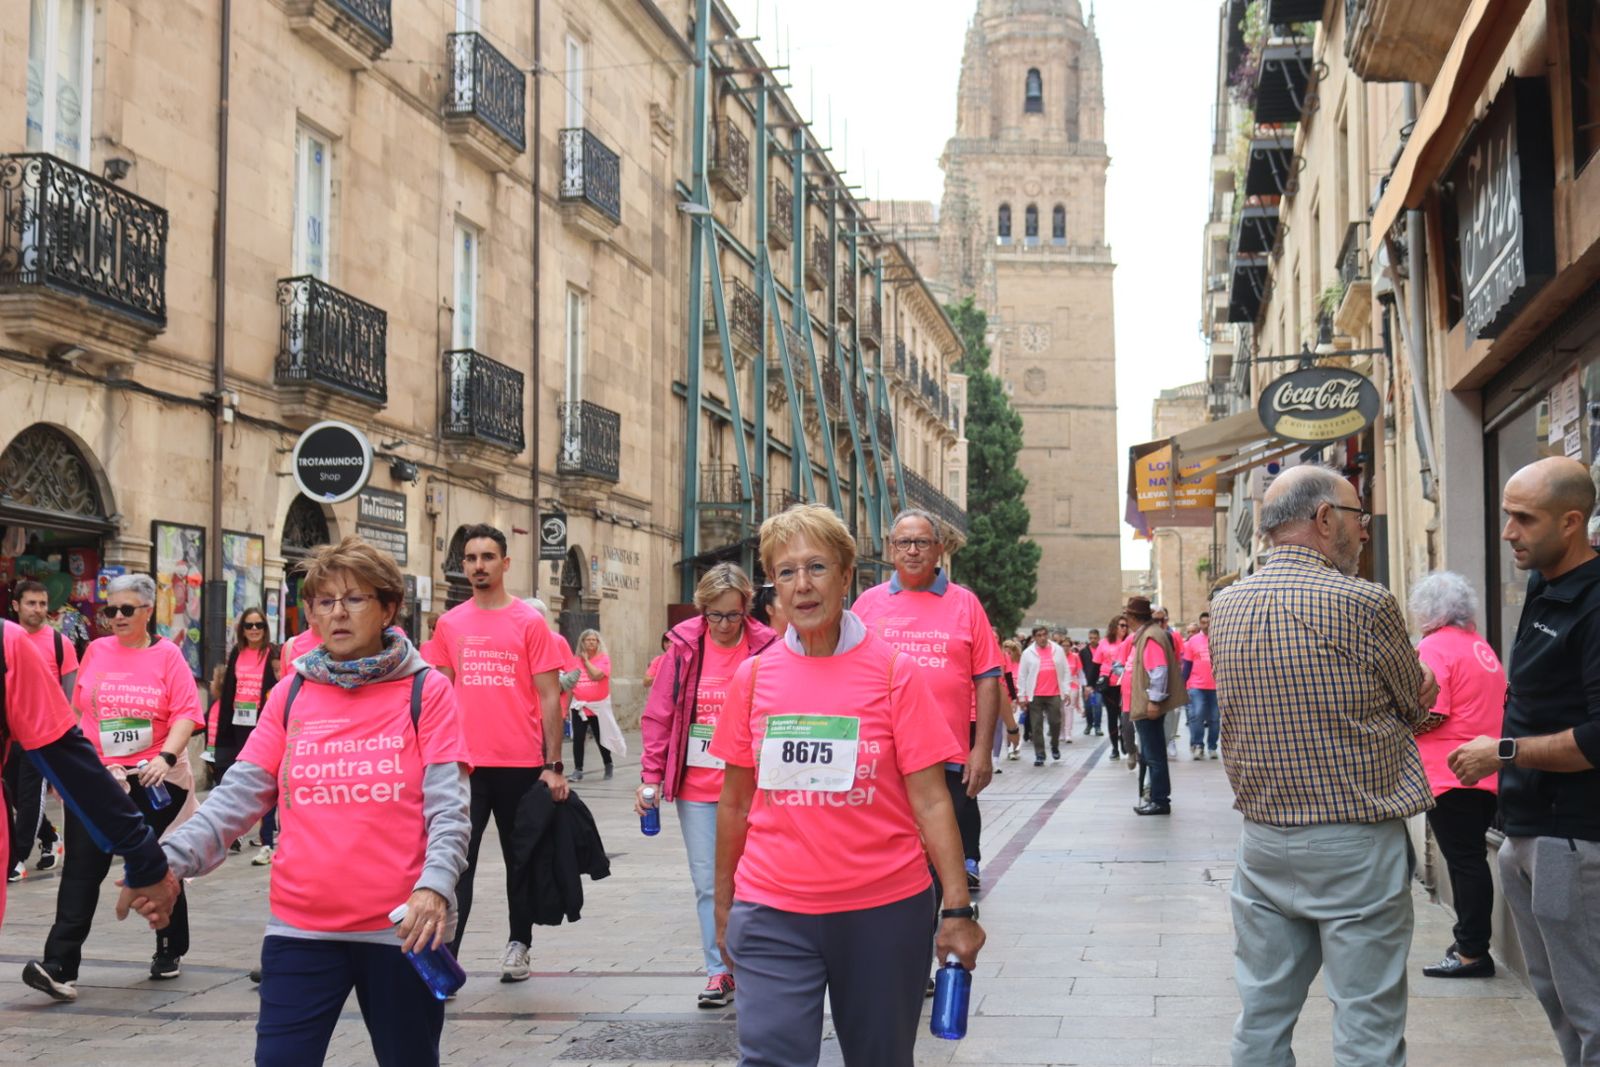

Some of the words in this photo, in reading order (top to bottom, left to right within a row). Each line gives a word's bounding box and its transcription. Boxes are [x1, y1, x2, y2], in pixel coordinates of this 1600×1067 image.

[1273, 378, 1362, 412] Coca-Cola
[298, 457, 363, 467] TROTAMUNDOS
[319, 472, 341, 481] Shop
[884, 628, 900, 638] En
[902, 630, 950, 640] marcha
[888, 642, 931, 653] ontra
[933, 642, 948, 653] el
[463, 648, 477, 658] En
[480, 650, 519, 662] marcha
[463, 661, 503, 673] contra
[503, 663, 517, 674] el
[463, 672, 517, 687] cáncer
[101, 682, 116, 691] En
[118, 684, 161, 695] marcha
[99, 693, 145, 705] contra
[146, 698, 159, 709] el
[113, 730, 139, 744] 2791
[295, 740, 318, 756] En
[324, 733, 405, 754] marcha
[782, 741, 833, 765] 8675
[291, 758, 374, 779] contra
[377, 753, 403, 775] el
[856, 759, 877, 779] el
[294, 780, 406, 806] cáncer
